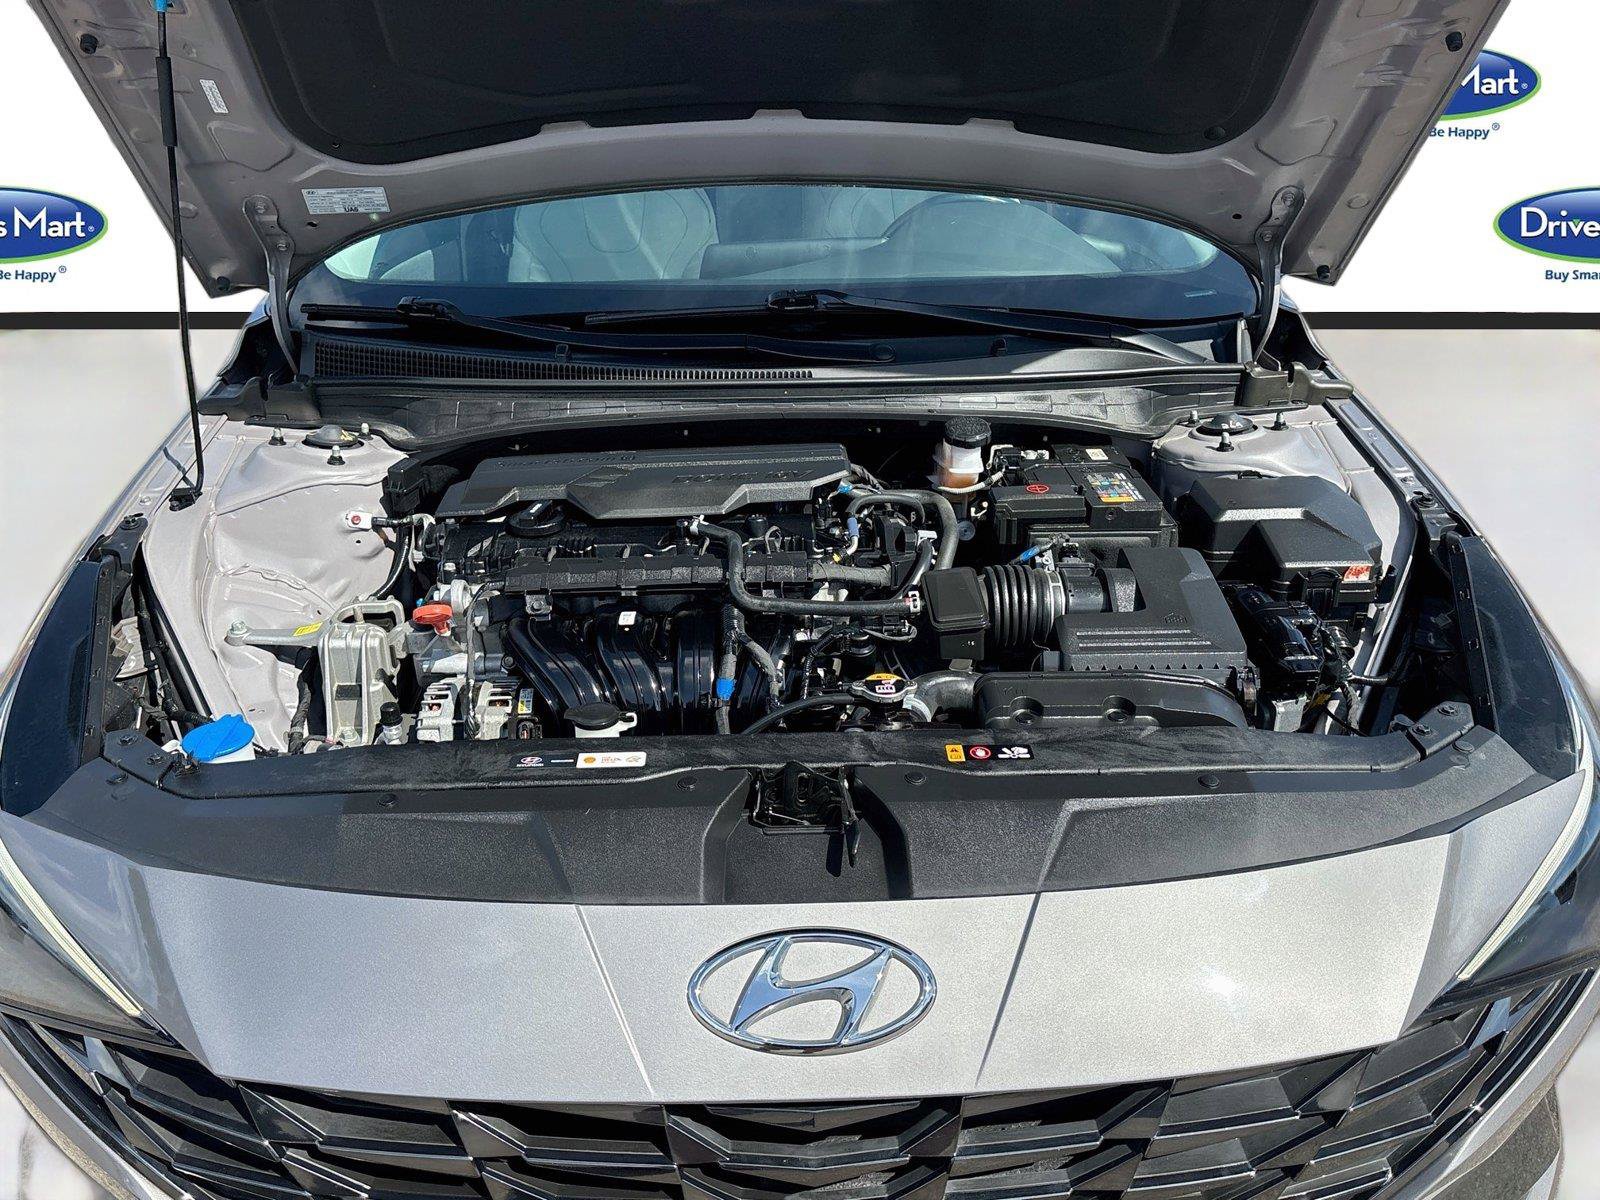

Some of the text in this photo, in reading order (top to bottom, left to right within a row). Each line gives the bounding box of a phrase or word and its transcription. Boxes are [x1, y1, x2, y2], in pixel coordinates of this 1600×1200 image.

[1448, 127, 1490, 140] Happy
[13, 206, 86, 237] Mart
[14, 270, 57, 283] Happy
[1545, 269, 1600, 283] Buy Sma
